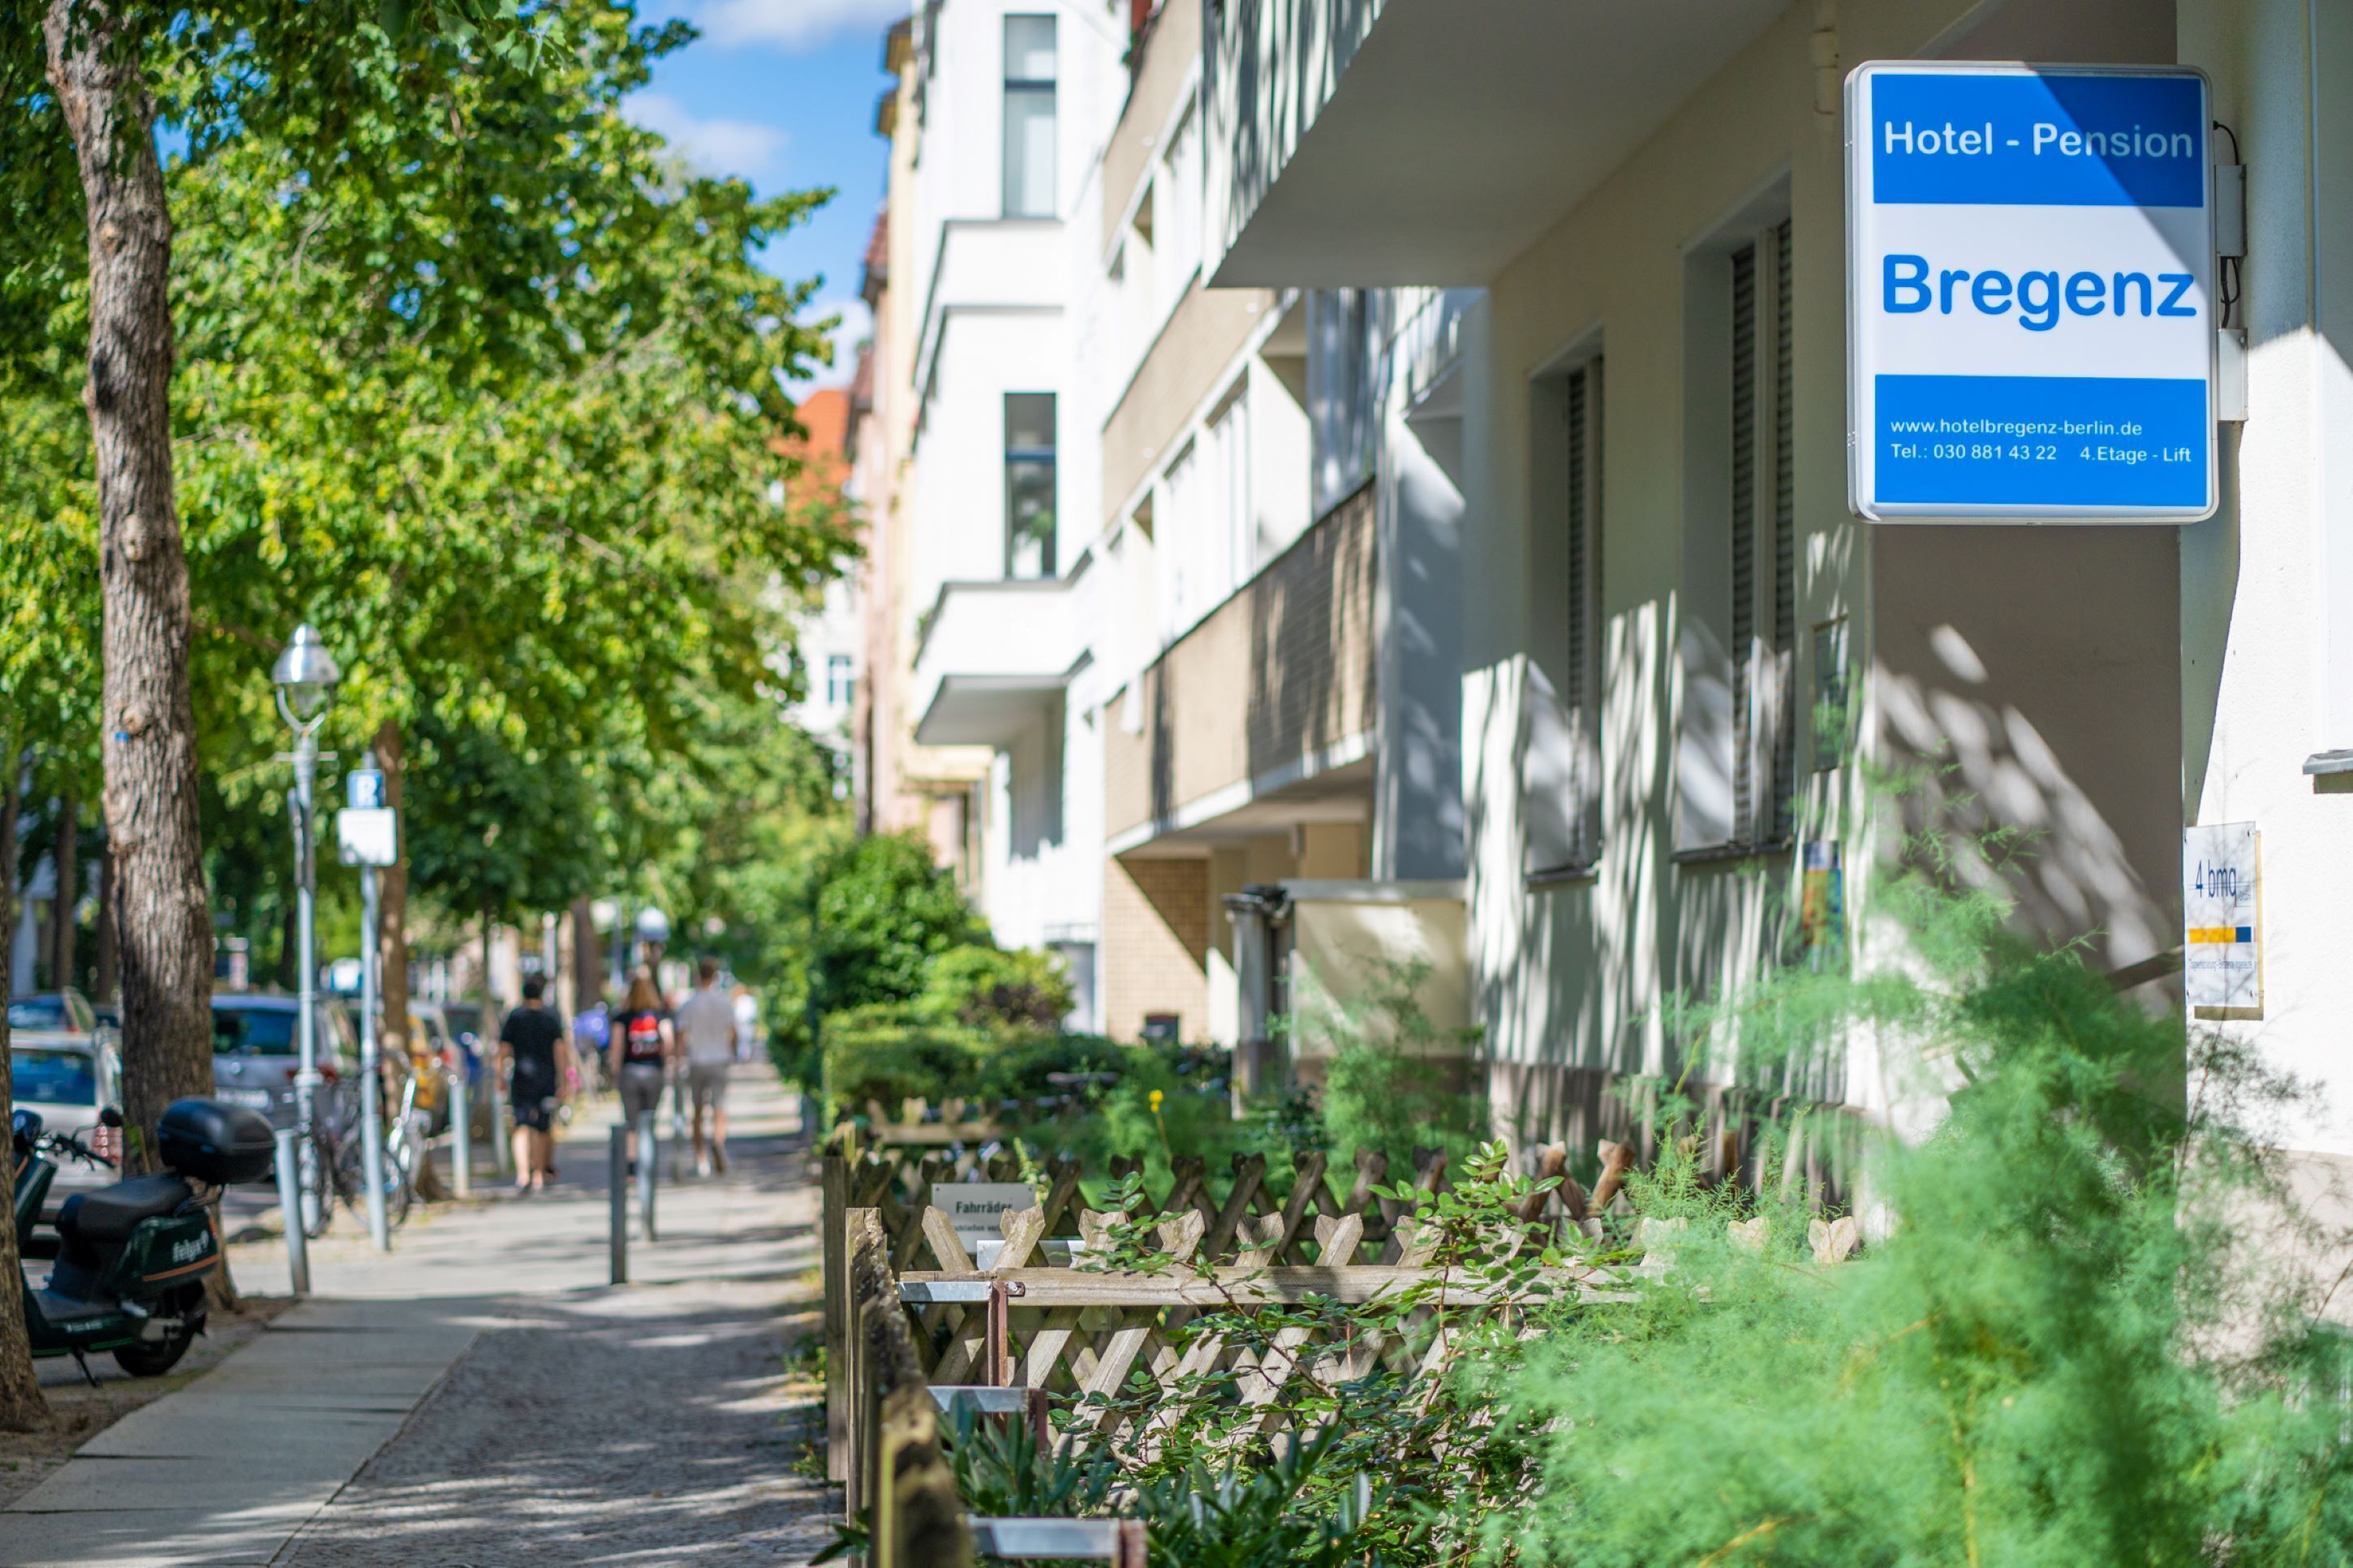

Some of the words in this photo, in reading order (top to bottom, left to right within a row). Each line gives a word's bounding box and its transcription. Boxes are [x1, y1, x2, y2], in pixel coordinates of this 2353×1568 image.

[1884, 121, 1993, 155] Hotel
[2033, 122, 2193, 157] Pension
[1882, 254, 2197, 332] Bregenz
[1891, 419, 2143, 437] www.hotelbregenz-berlin.de
[1891, 444, 1928, 459] Tel.:
[1934, 445, 1966, 459] 030
[1971, 445, 2002, 460] 881
[2008, 446, 2030, 460] 43
[2036, 447, 2057, 461] 22
[2163, 448, 2192, 462] Lift
[2196, 860, 2204, 898] 4
